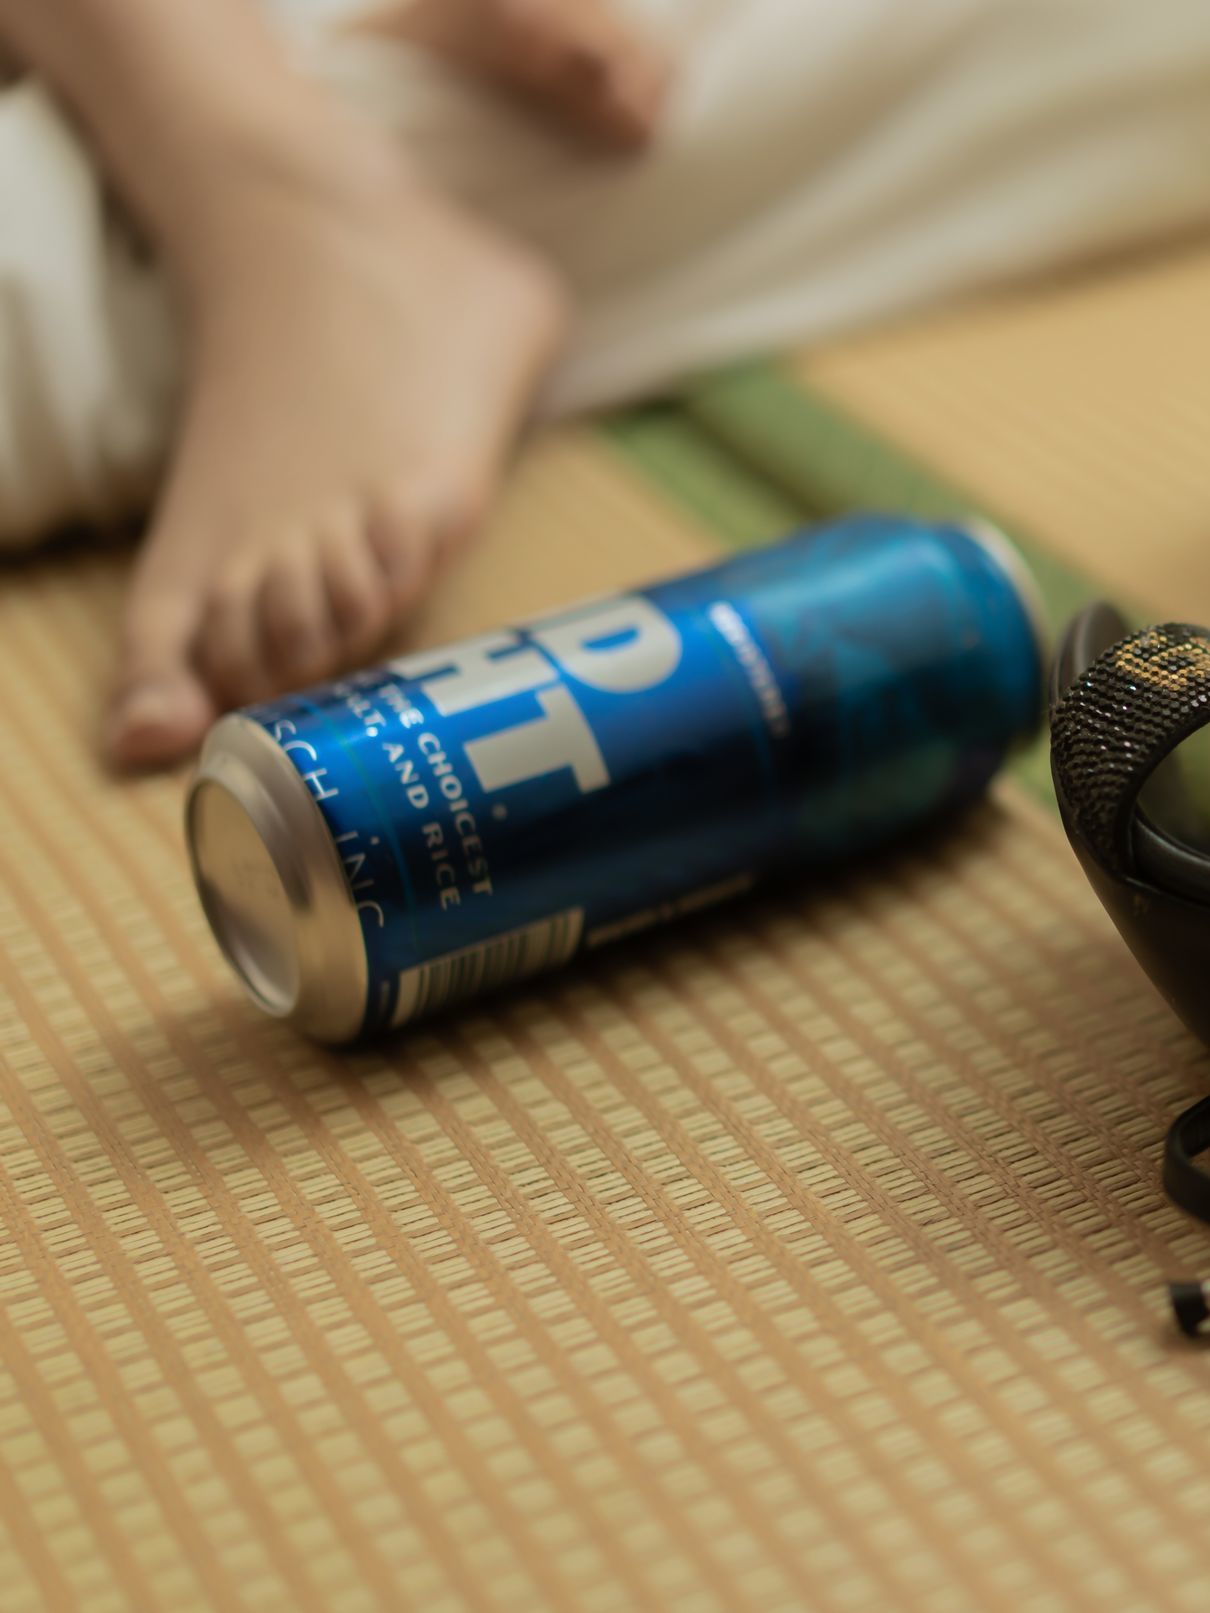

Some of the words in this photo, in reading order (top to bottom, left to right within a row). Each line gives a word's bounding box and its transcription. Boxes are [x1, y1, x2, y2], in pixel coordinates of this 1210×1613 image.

[382, 742, 430, 810] AND
[422, 822, 462, 912] RICE
[418, 732, 493, 896] CHOICEST
